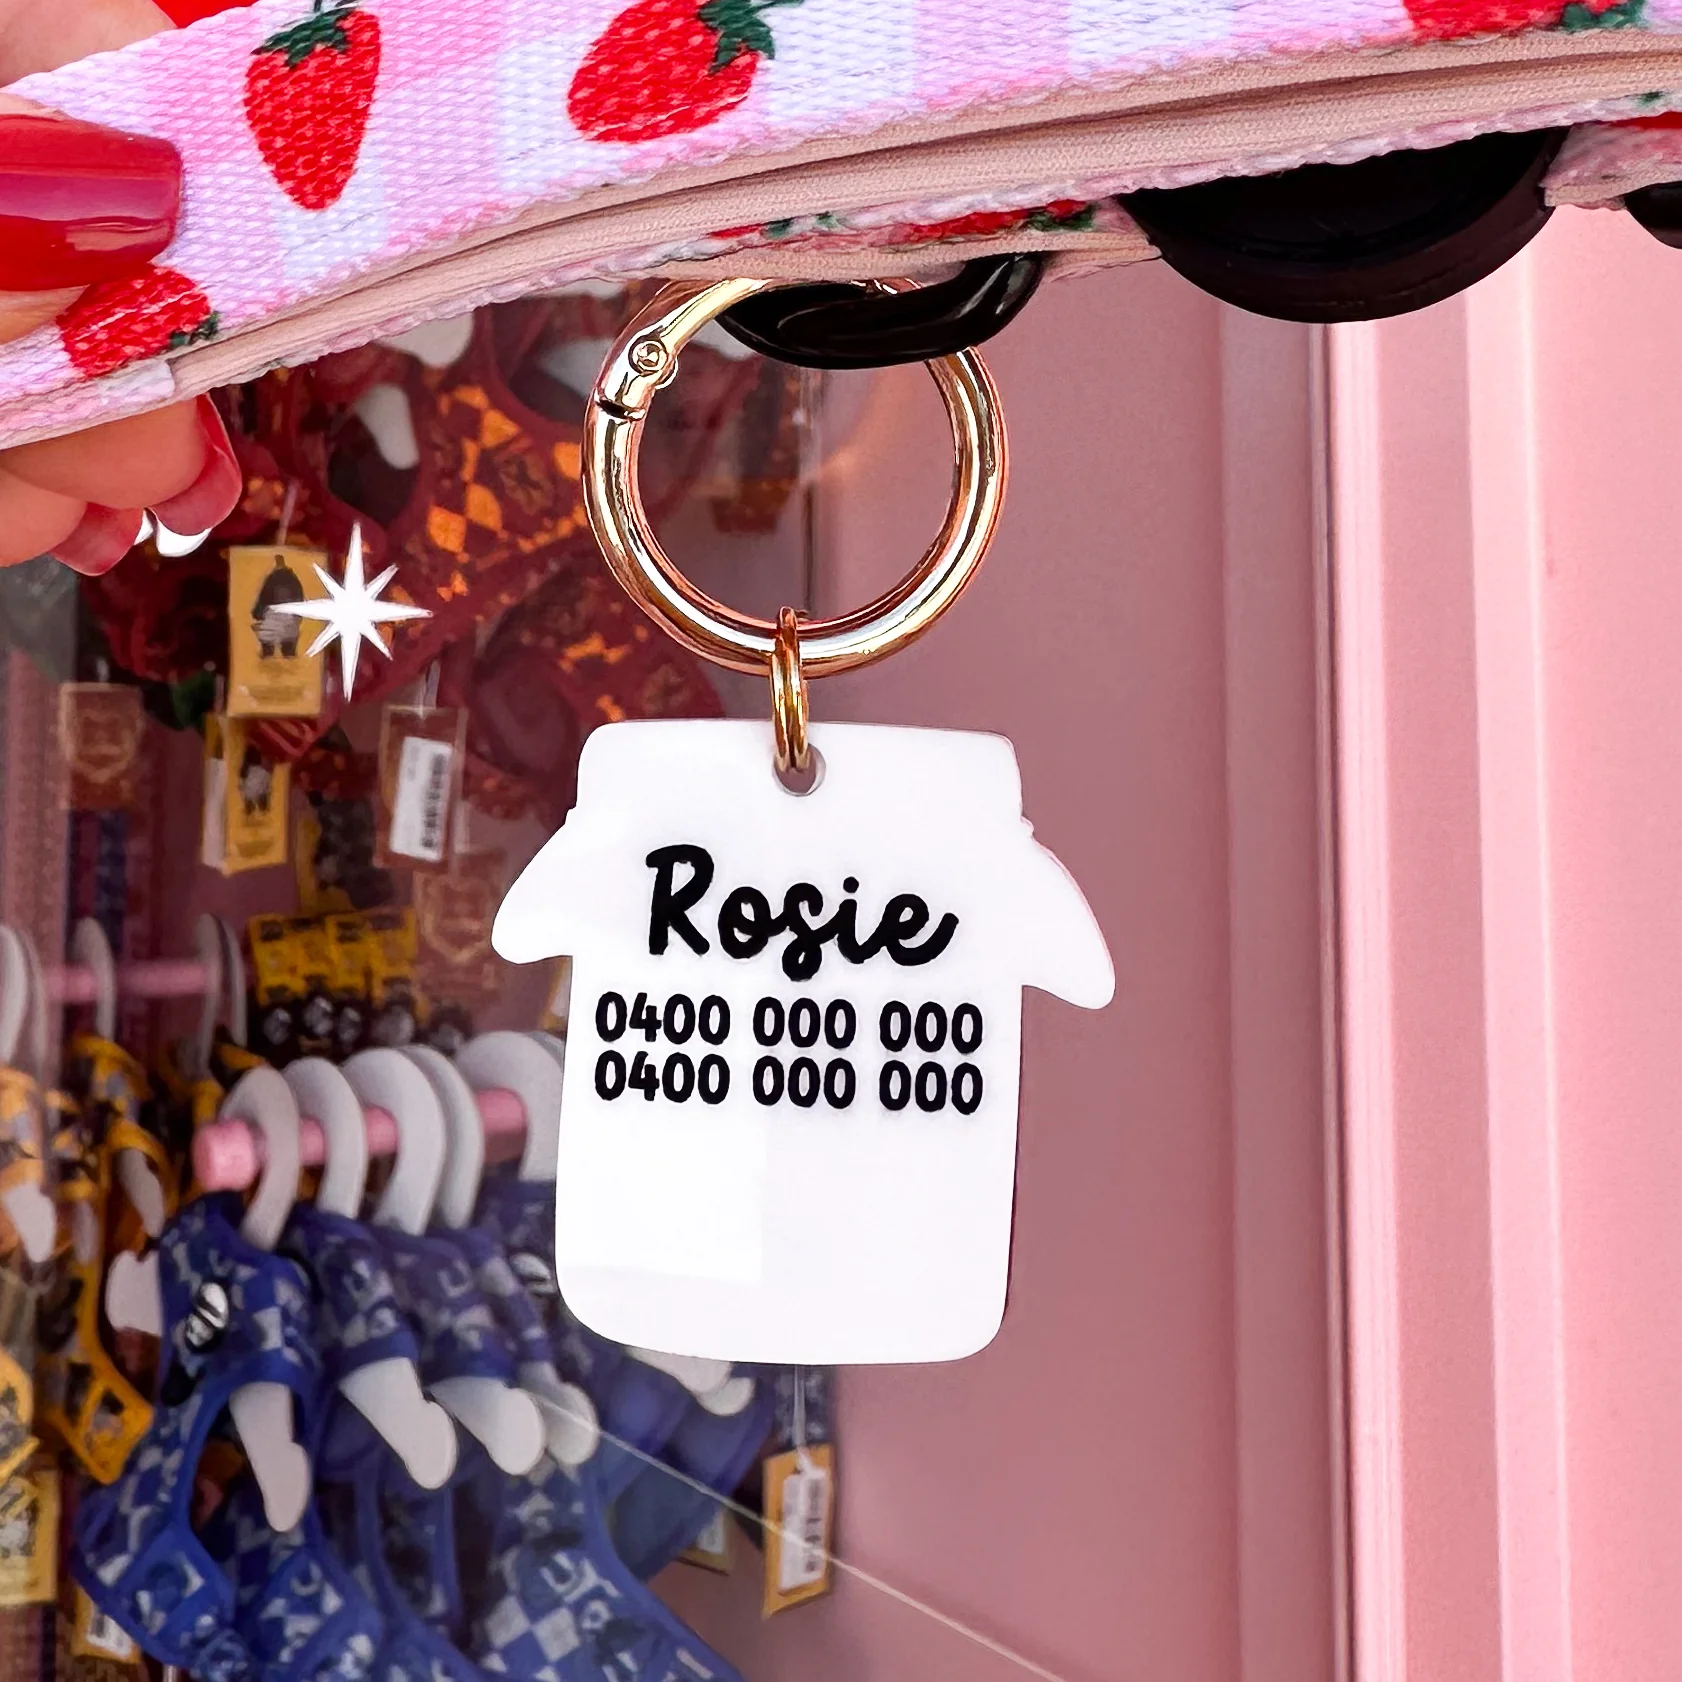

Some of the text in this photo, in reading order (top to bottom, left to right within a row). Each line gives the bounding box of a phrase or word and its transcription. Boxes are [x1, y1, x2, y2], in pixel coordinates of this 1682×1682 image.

[645, 843, 960, 983] Rosie
[595, 991, 983, 1055] 0400 000 000
[594, 1049, 984, 1116] 0400 000 000
